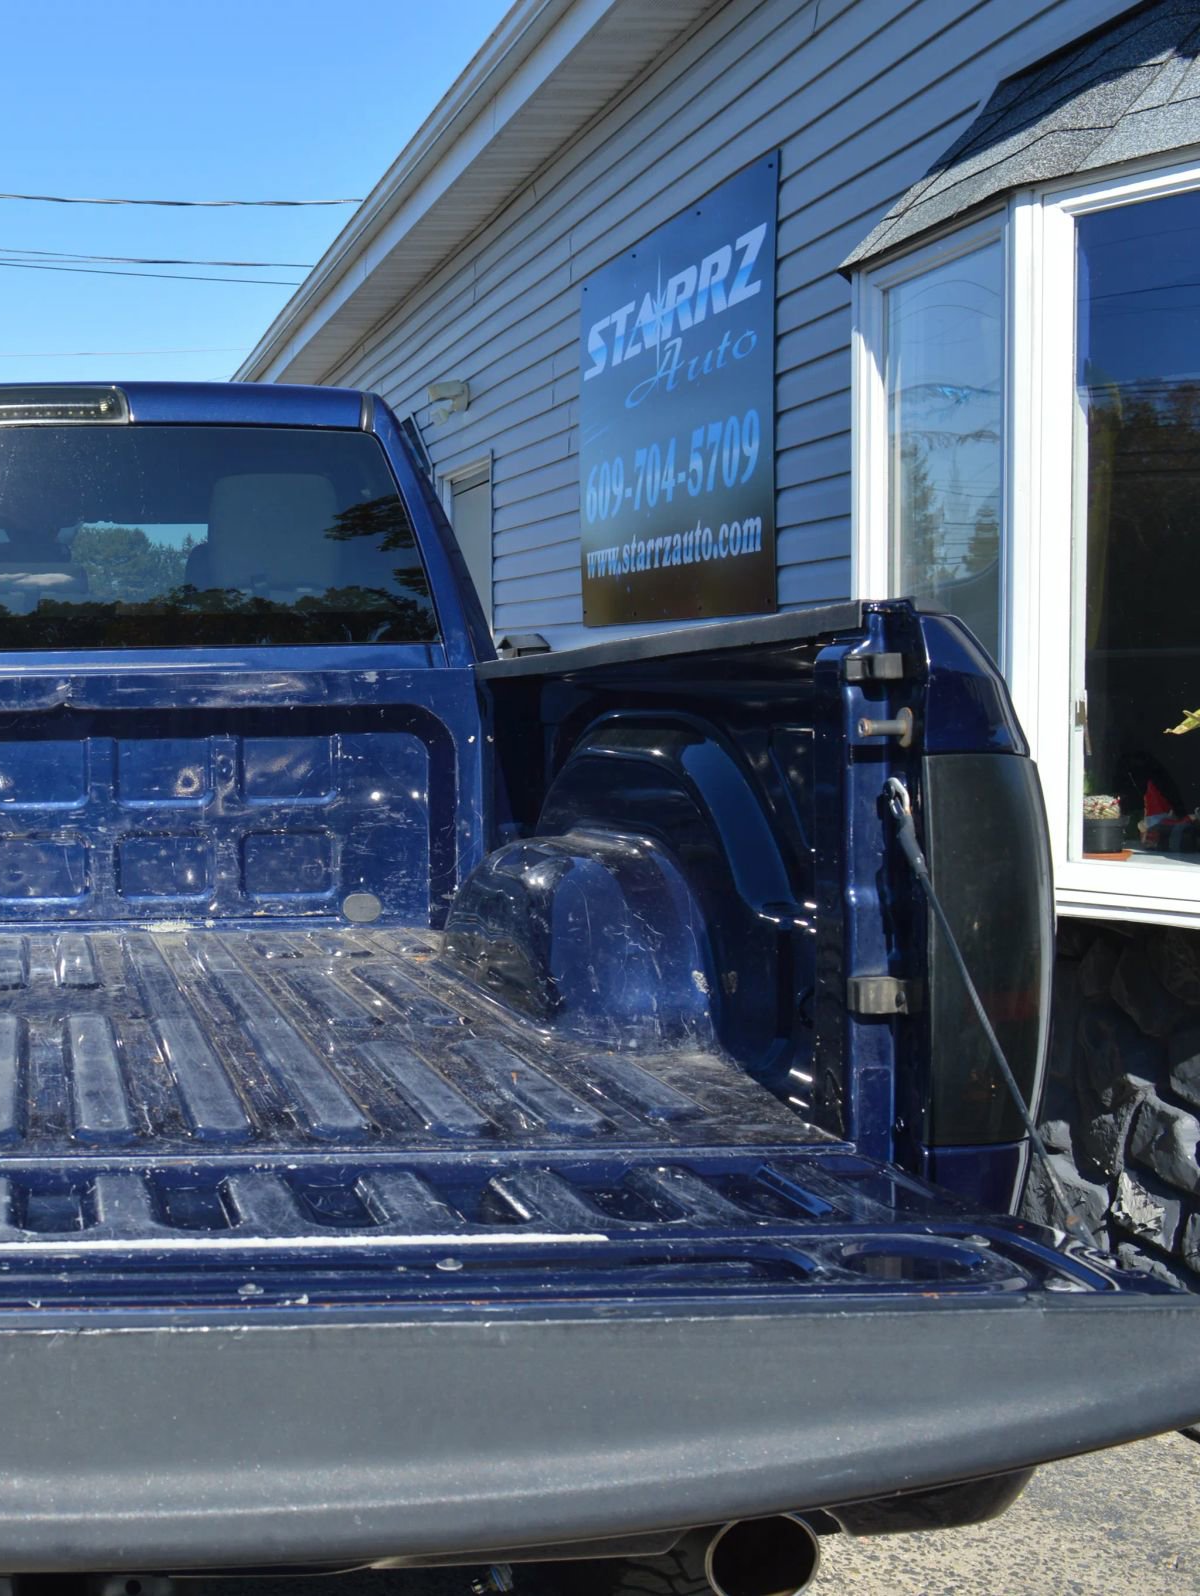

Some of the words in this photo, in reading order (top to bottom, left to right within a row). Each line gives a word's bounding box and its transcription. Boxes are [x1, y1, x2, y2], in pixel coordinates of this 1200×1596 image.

[583, 222, 767, 382] STARRZ
[624, 329, 758, 409] Auto
[586, 409, 761, 524] 609-704-5709
[586, 516, 762, 580] www.starrzauto.com
